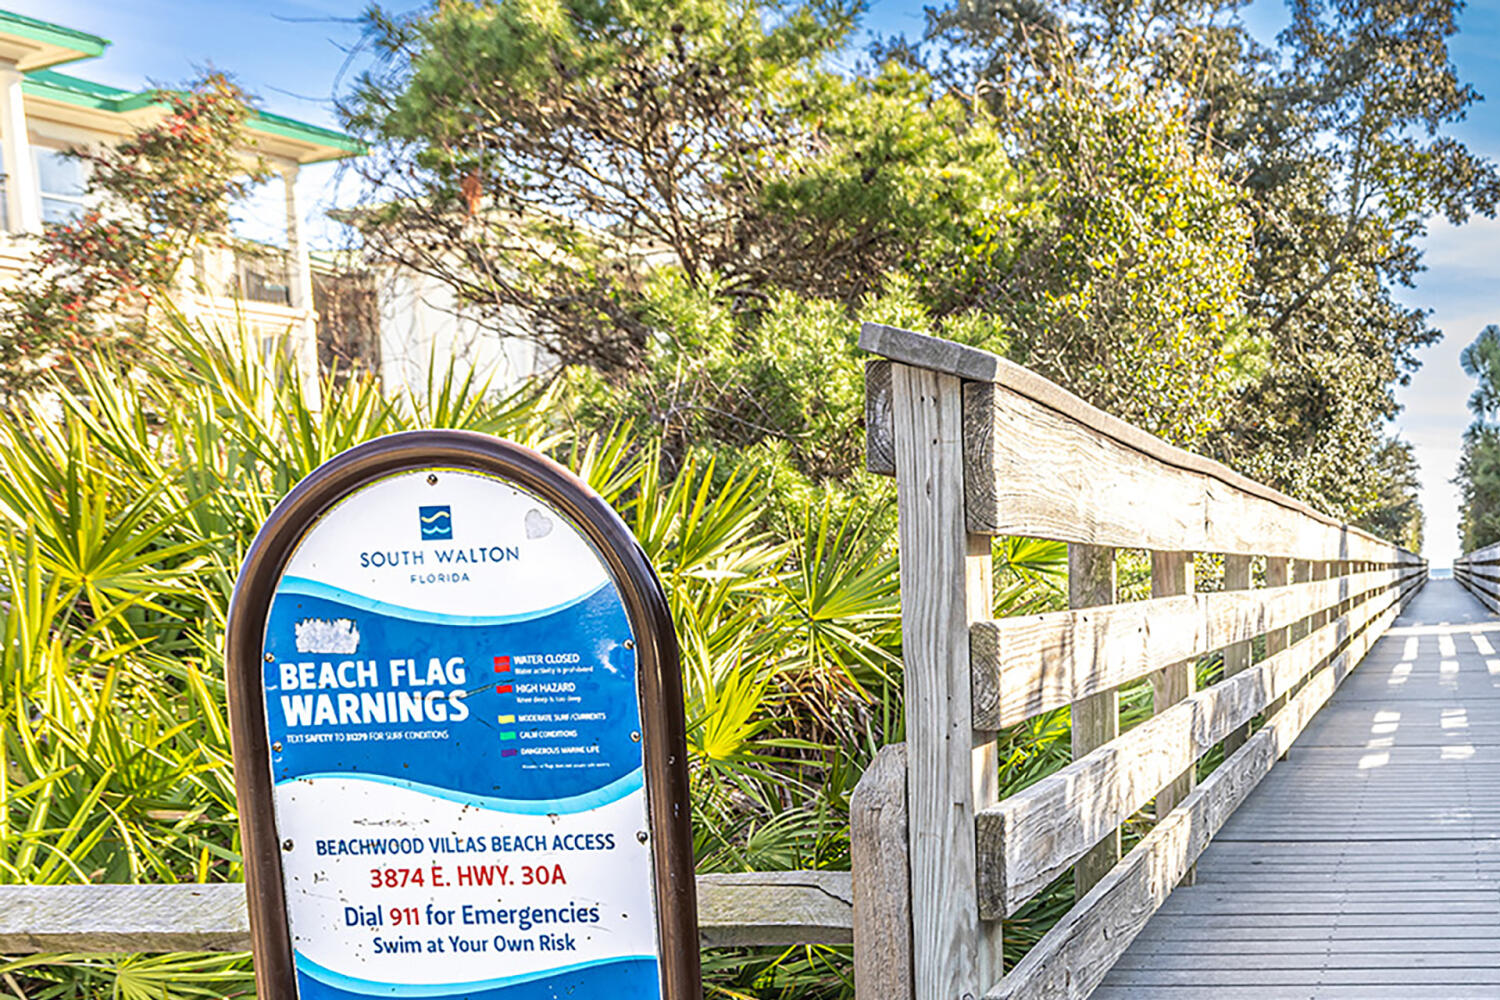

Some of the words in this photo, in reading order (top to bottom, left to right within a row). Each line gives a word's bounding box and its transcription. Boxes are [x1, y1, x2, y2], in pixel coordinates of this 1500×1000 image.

[360, 551, 424, 568] SOUTH
[434, 546, 519, 563] WALTON
[410, 573, 470, 584] FLORIDA
[513, 654, 543, 665] WATER
[544, 653, 580, 664] CLOSED
[279, 660, 378, 690] BEACH
[390, 657, 466, 686] FLAG
[515, 683, 538, 693] HIGH
[540, 682, 576, 693] HAZARD
[281, 689, 469, 726] WARNINGS
[369, 731, 384, 741] FOR
[538, 730, 578, 739] CONDITIONS
[521, 747, 560, 755] DANGEROUS
[316, 838, 424, 856] BEACHWOOD
[428, 836, 487, 854] VILLAS
[491, 835, 547, 852] BEACH
[552, 834, 615, 851] ACCESS
[370, 868, 424, 888] 3874
[432, 866, 450, 887] E.
[458, 865, 514, 886] HWY.
[522, 864, 566, 885] 30A
[344, 905, 383, 926] Dial
[389, 907, 420, 925] 911
[426, 904, 455, 925] for
[462, 902, 600, 930] Emergencies
[373, 936, 421, 954] Swim
[427, 937, 444, 953] at
[448, 936, 488, 953] Your
[493, 935, 534, 951] Own
[539, 933, 576, 951] Risk
